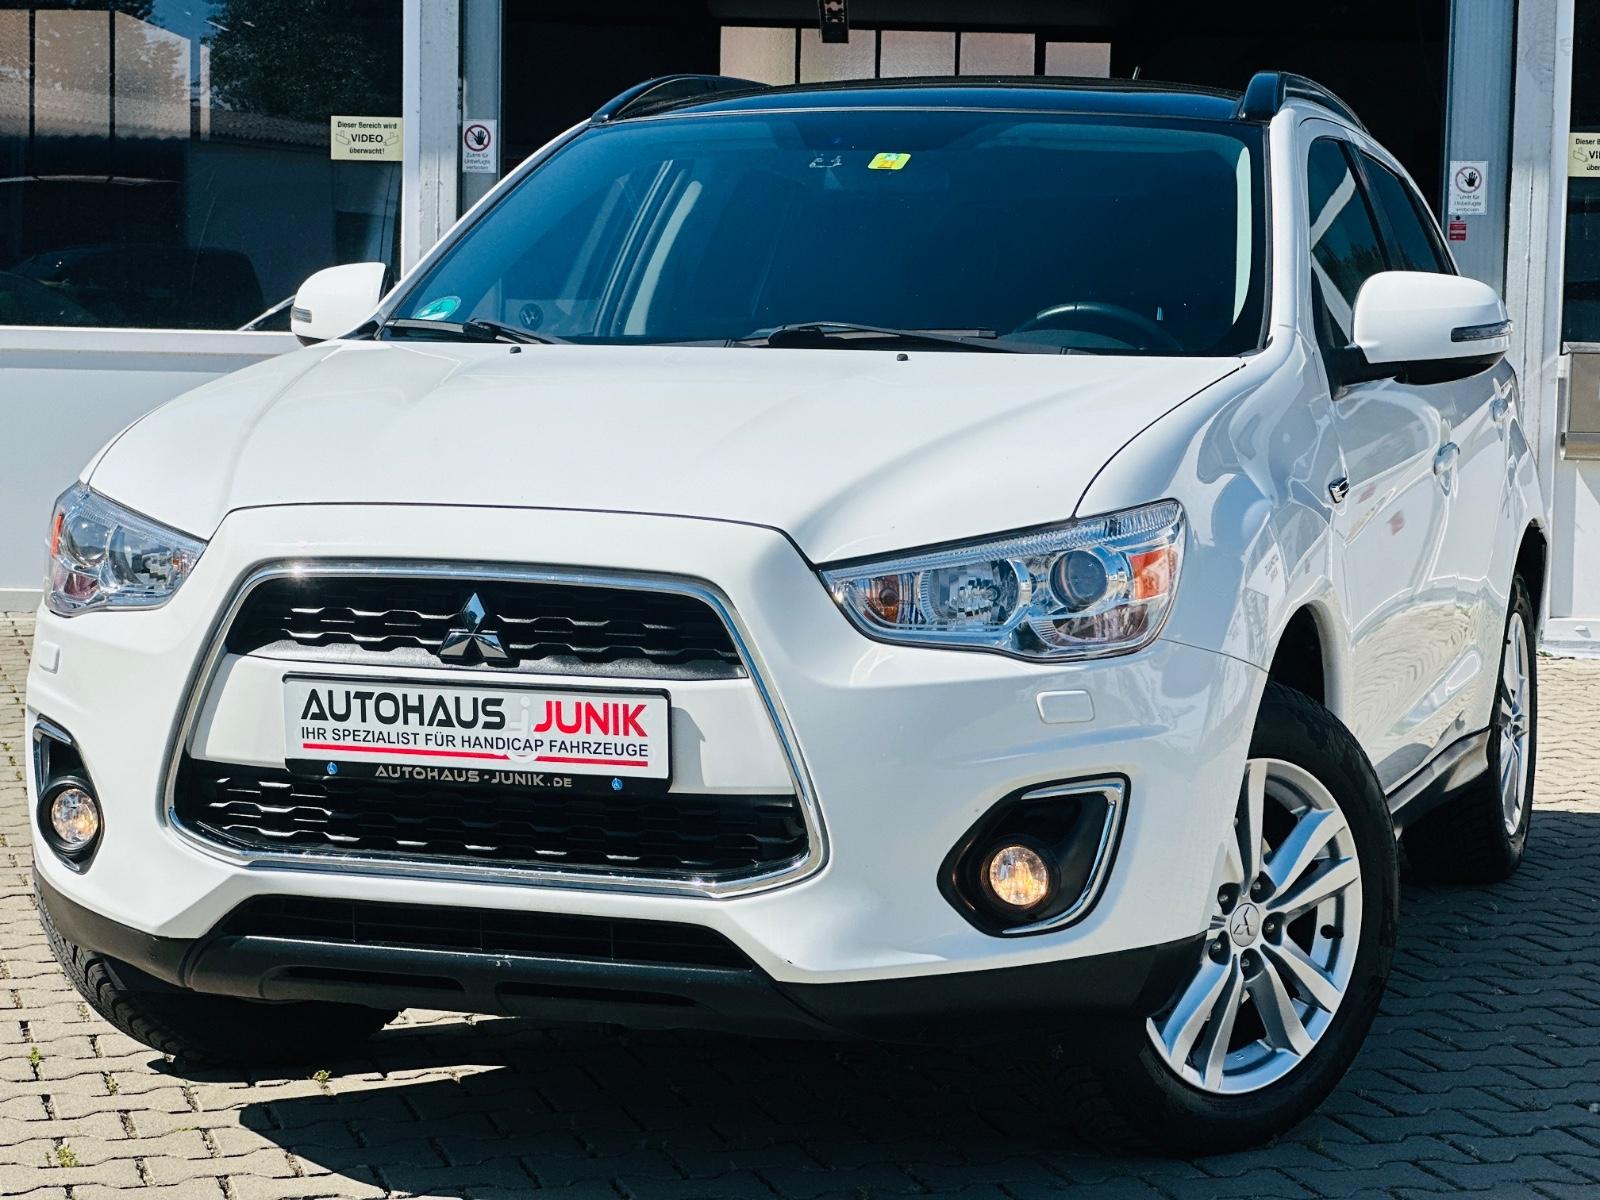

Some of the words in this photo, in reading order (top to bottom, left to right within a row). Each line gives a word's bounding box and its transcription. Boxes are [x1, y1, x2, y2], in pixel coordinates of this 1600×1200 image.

[351, 133, 384, 143] VIDEO
[349, 146, 385, 155] überwacht!
[300, 688, 506, 730] AUTOHAUS
[533, 700, 649, 738] JUNIK
[301, 726, 328, 741] IHR
[332, 727, 420, 745] SPEZIALIST
[425, 731, 456, 747] FÜR
[461, 735, 544, 752] HANDICAP
[549, 740, 649, 757] FAHRZEUGE
